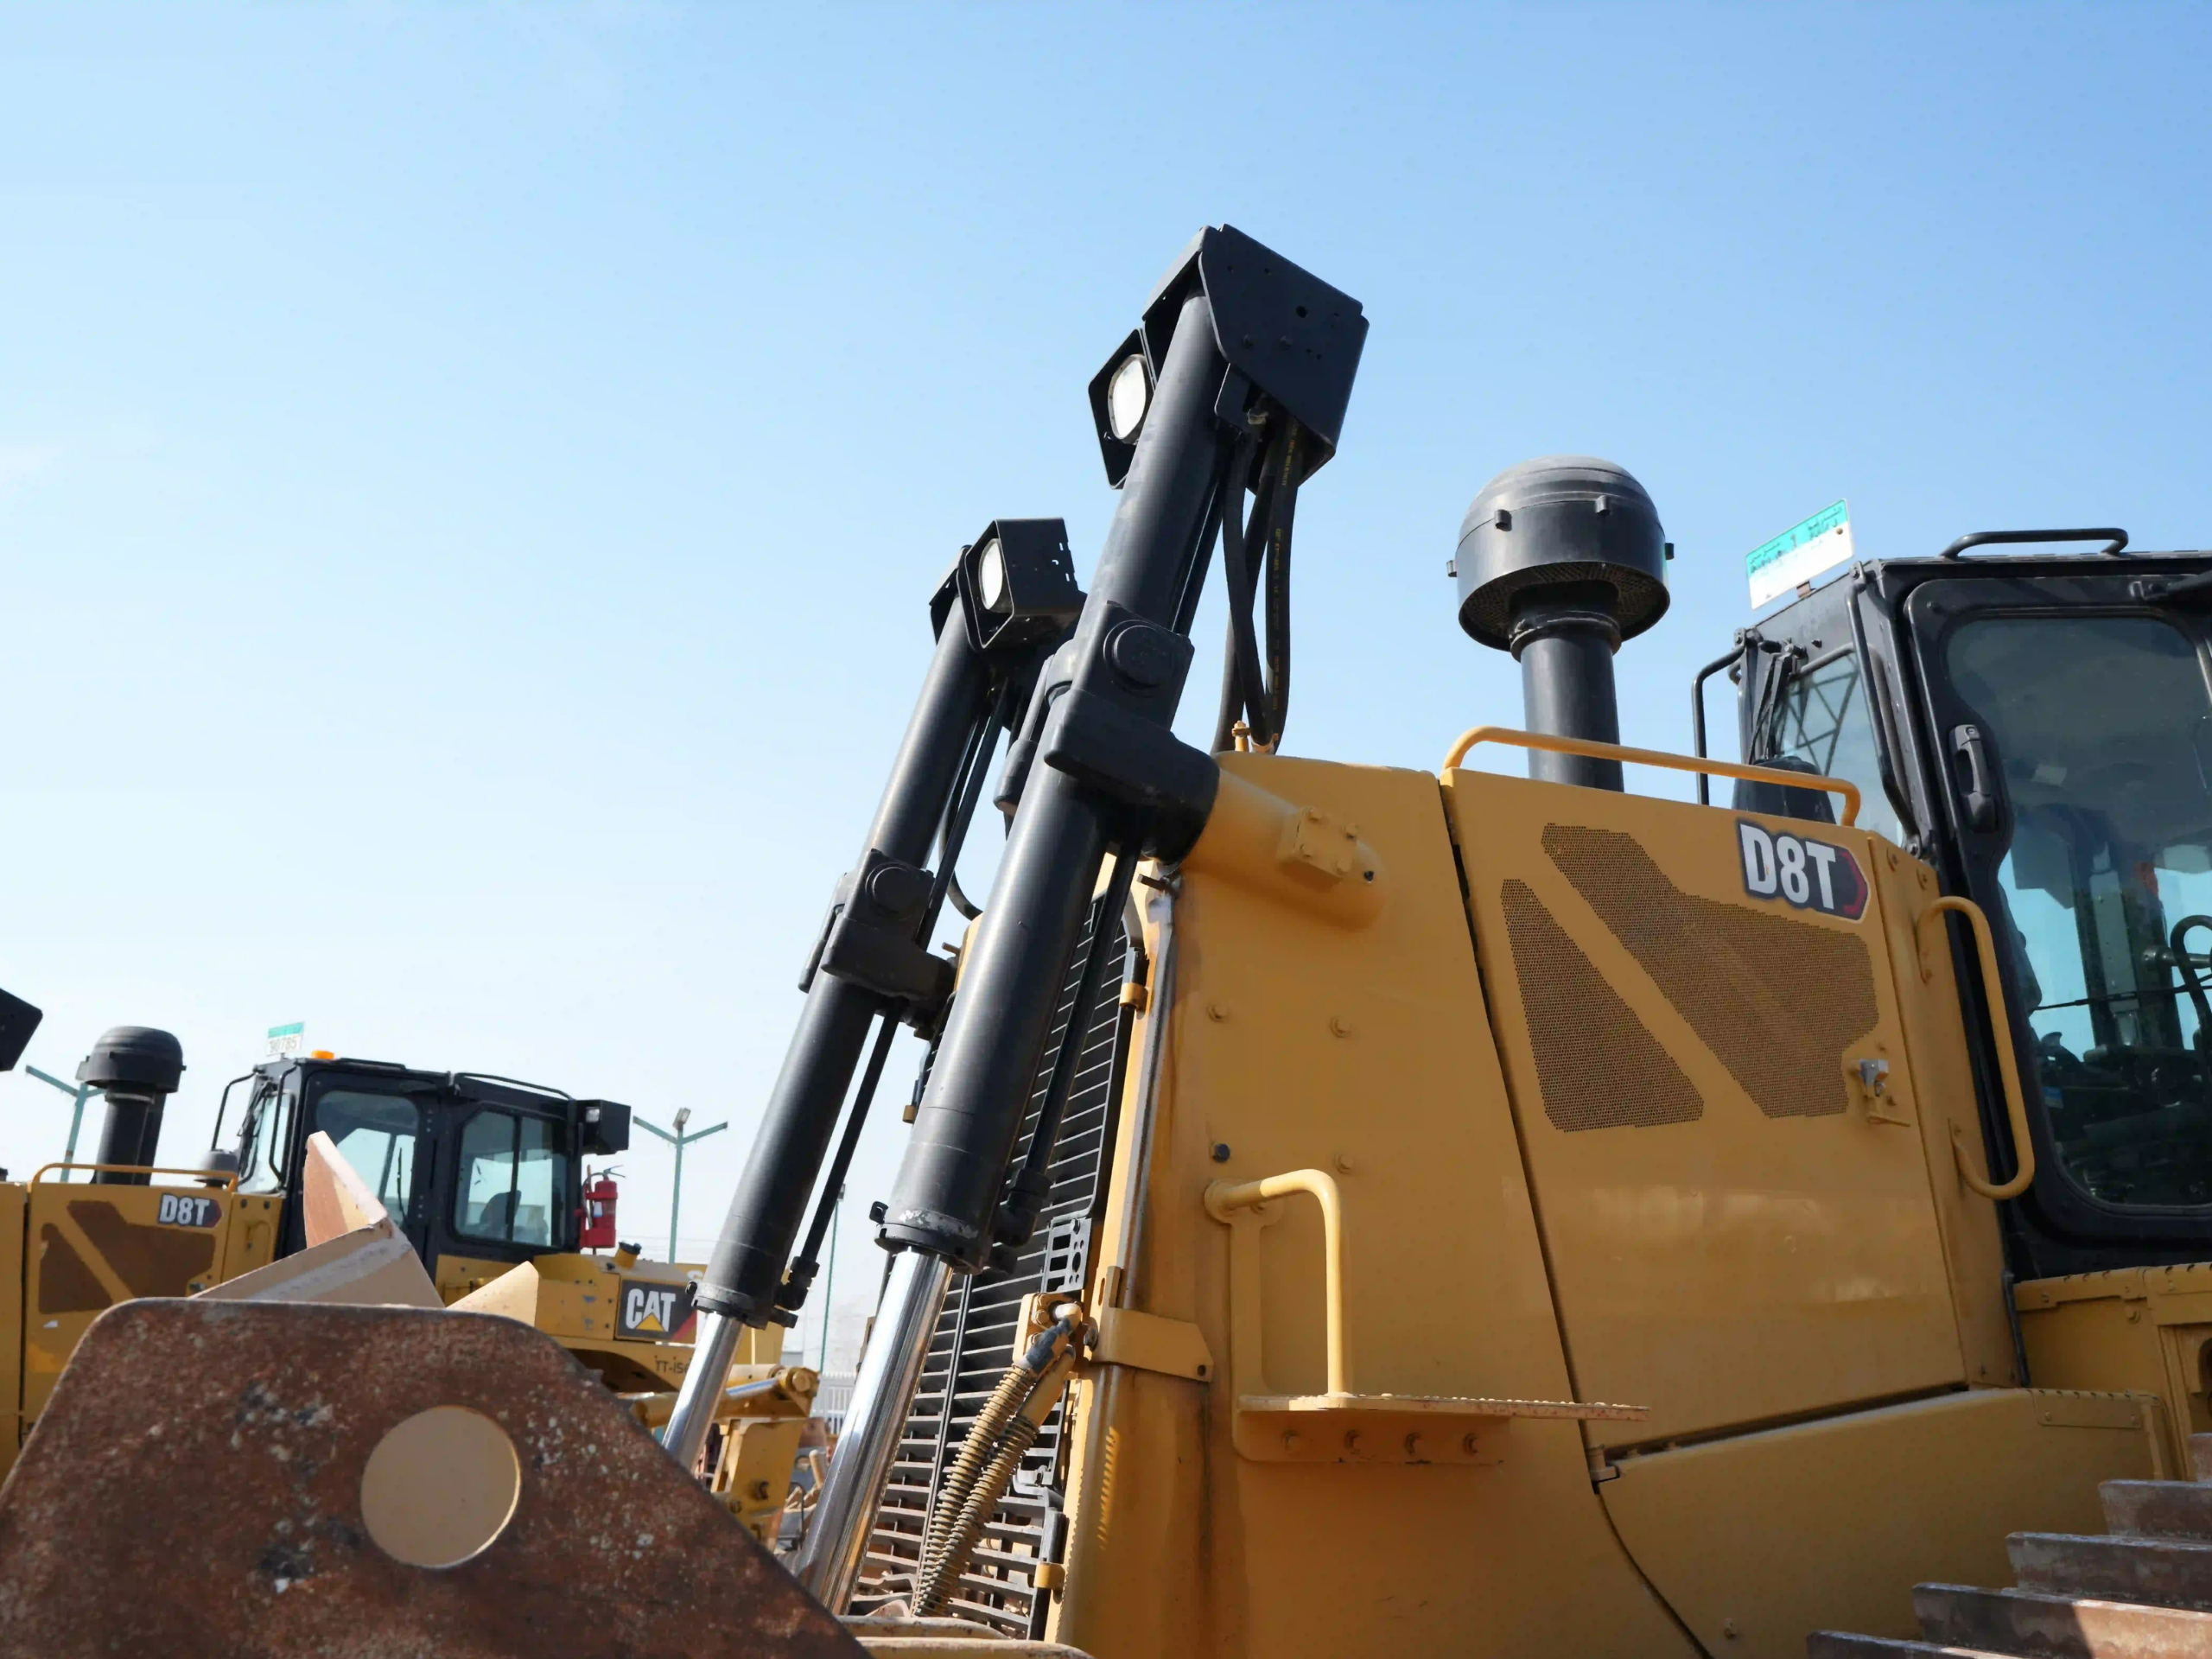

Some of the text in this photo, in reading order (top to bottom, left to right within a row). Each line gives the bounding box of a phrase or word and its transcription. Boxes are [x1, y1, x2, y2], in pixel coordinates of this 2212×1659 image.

[1739, 823, 1835, 910] D8T
[160, 1195, 210, 1225] D8T
[626, 1288, 677, 1332] CAT
